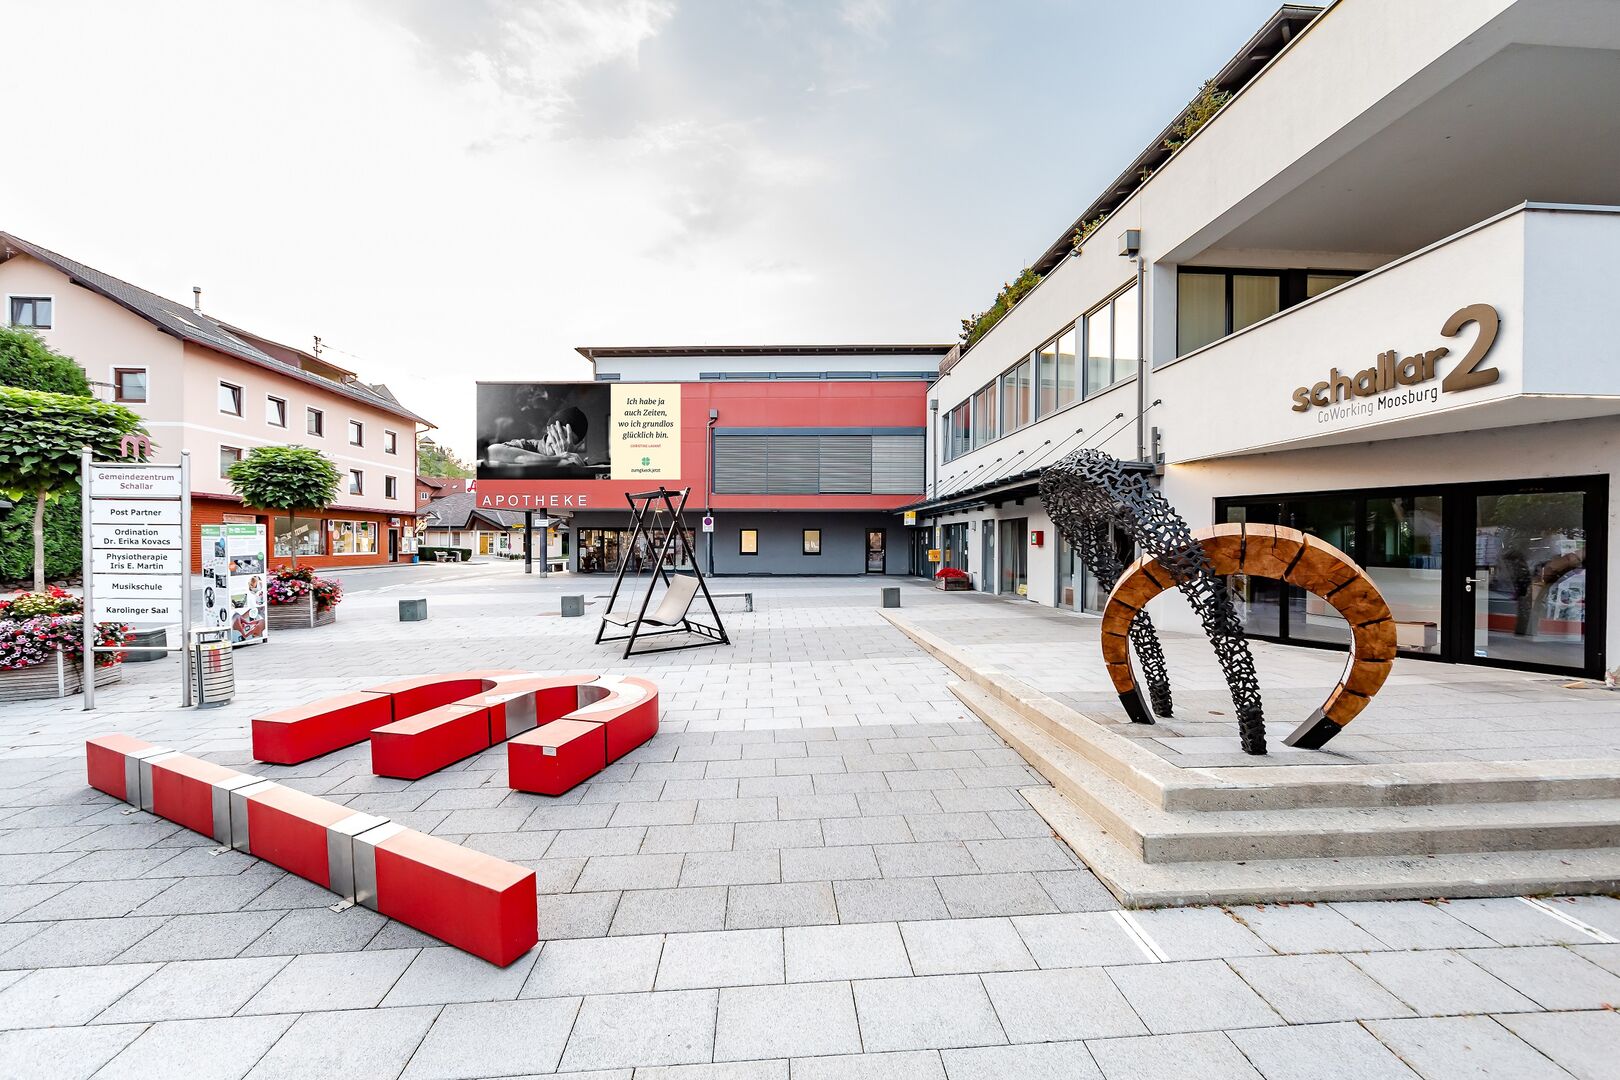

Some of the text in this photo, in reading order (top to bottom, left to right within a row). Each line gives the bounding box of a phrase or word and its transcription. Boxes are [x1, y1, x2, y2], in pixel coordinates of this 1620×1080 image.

[1291, 303, 1501, 412] schallar 2
[657, 398, 665, 406] ja
[1317, 386, 1439, 424] CoWorking Moosburg
[643, 409, 667, 417] Zeiten,
[642, 420, 674, 429] grundlos
[622, 431, 654, 440] glücklich
[482, 495, 587, 506] APOTHEKE
[106, 607, 148, 615] Karolinger
